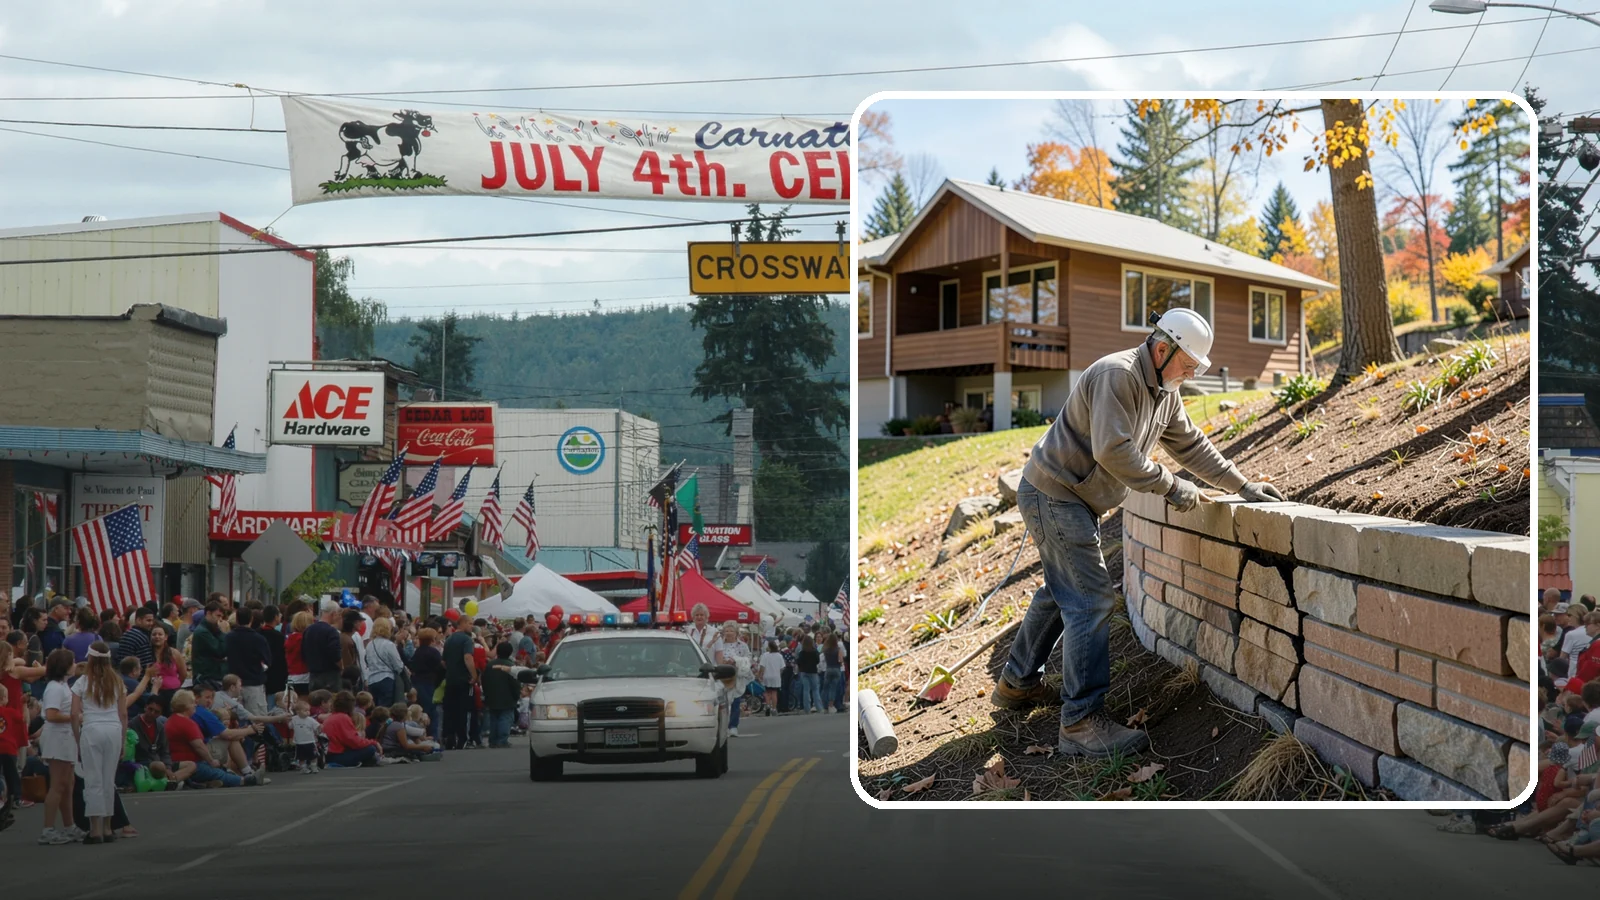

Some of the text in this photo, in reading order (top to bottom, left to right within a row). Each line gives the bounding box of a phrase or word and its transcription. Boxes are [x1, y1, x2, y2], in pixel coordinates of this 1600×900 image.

[481, 141, 605, 192] JULY
[632, 150, 746, 198] 4th.
[696, 254, 850, 280] CROSSWA
[283, 380, 373, 420] ACE
[405, 409, 485, 422] CEDAR LOG
[283, 421, 371, 436] Hardware
[353, 467, 388, 480] Simpl
[83, 485, 155, 496] St. Vincent de Paul
[688, 526, 742, 536] CRNATION
[699, 535, 730, 544] GLASS
